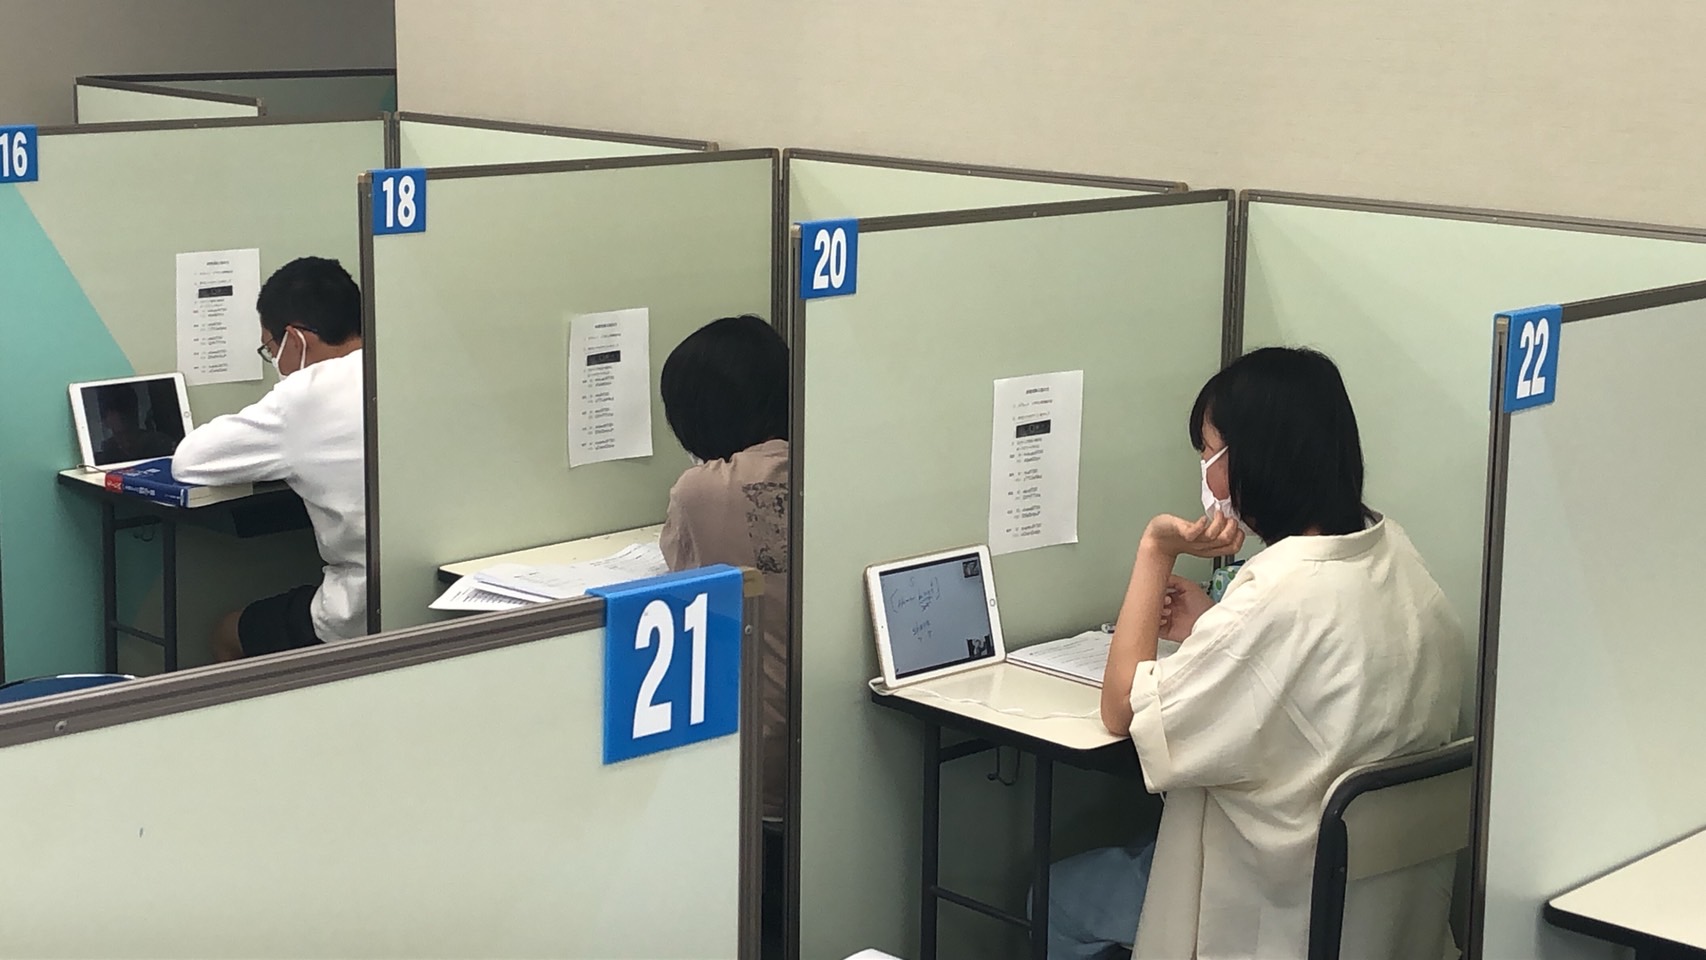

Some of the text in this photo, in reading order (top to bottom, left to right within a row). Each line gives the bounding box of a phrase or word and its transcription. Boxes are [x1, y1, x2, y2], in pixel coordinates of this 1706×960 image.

[0, 131, 28, 177] 16
[382, 175, 416, 228] 18
[812, 227, 847, 290] 20
[1516, 317, 1549, 399] 22
[632, 592, 708, 739] 21
